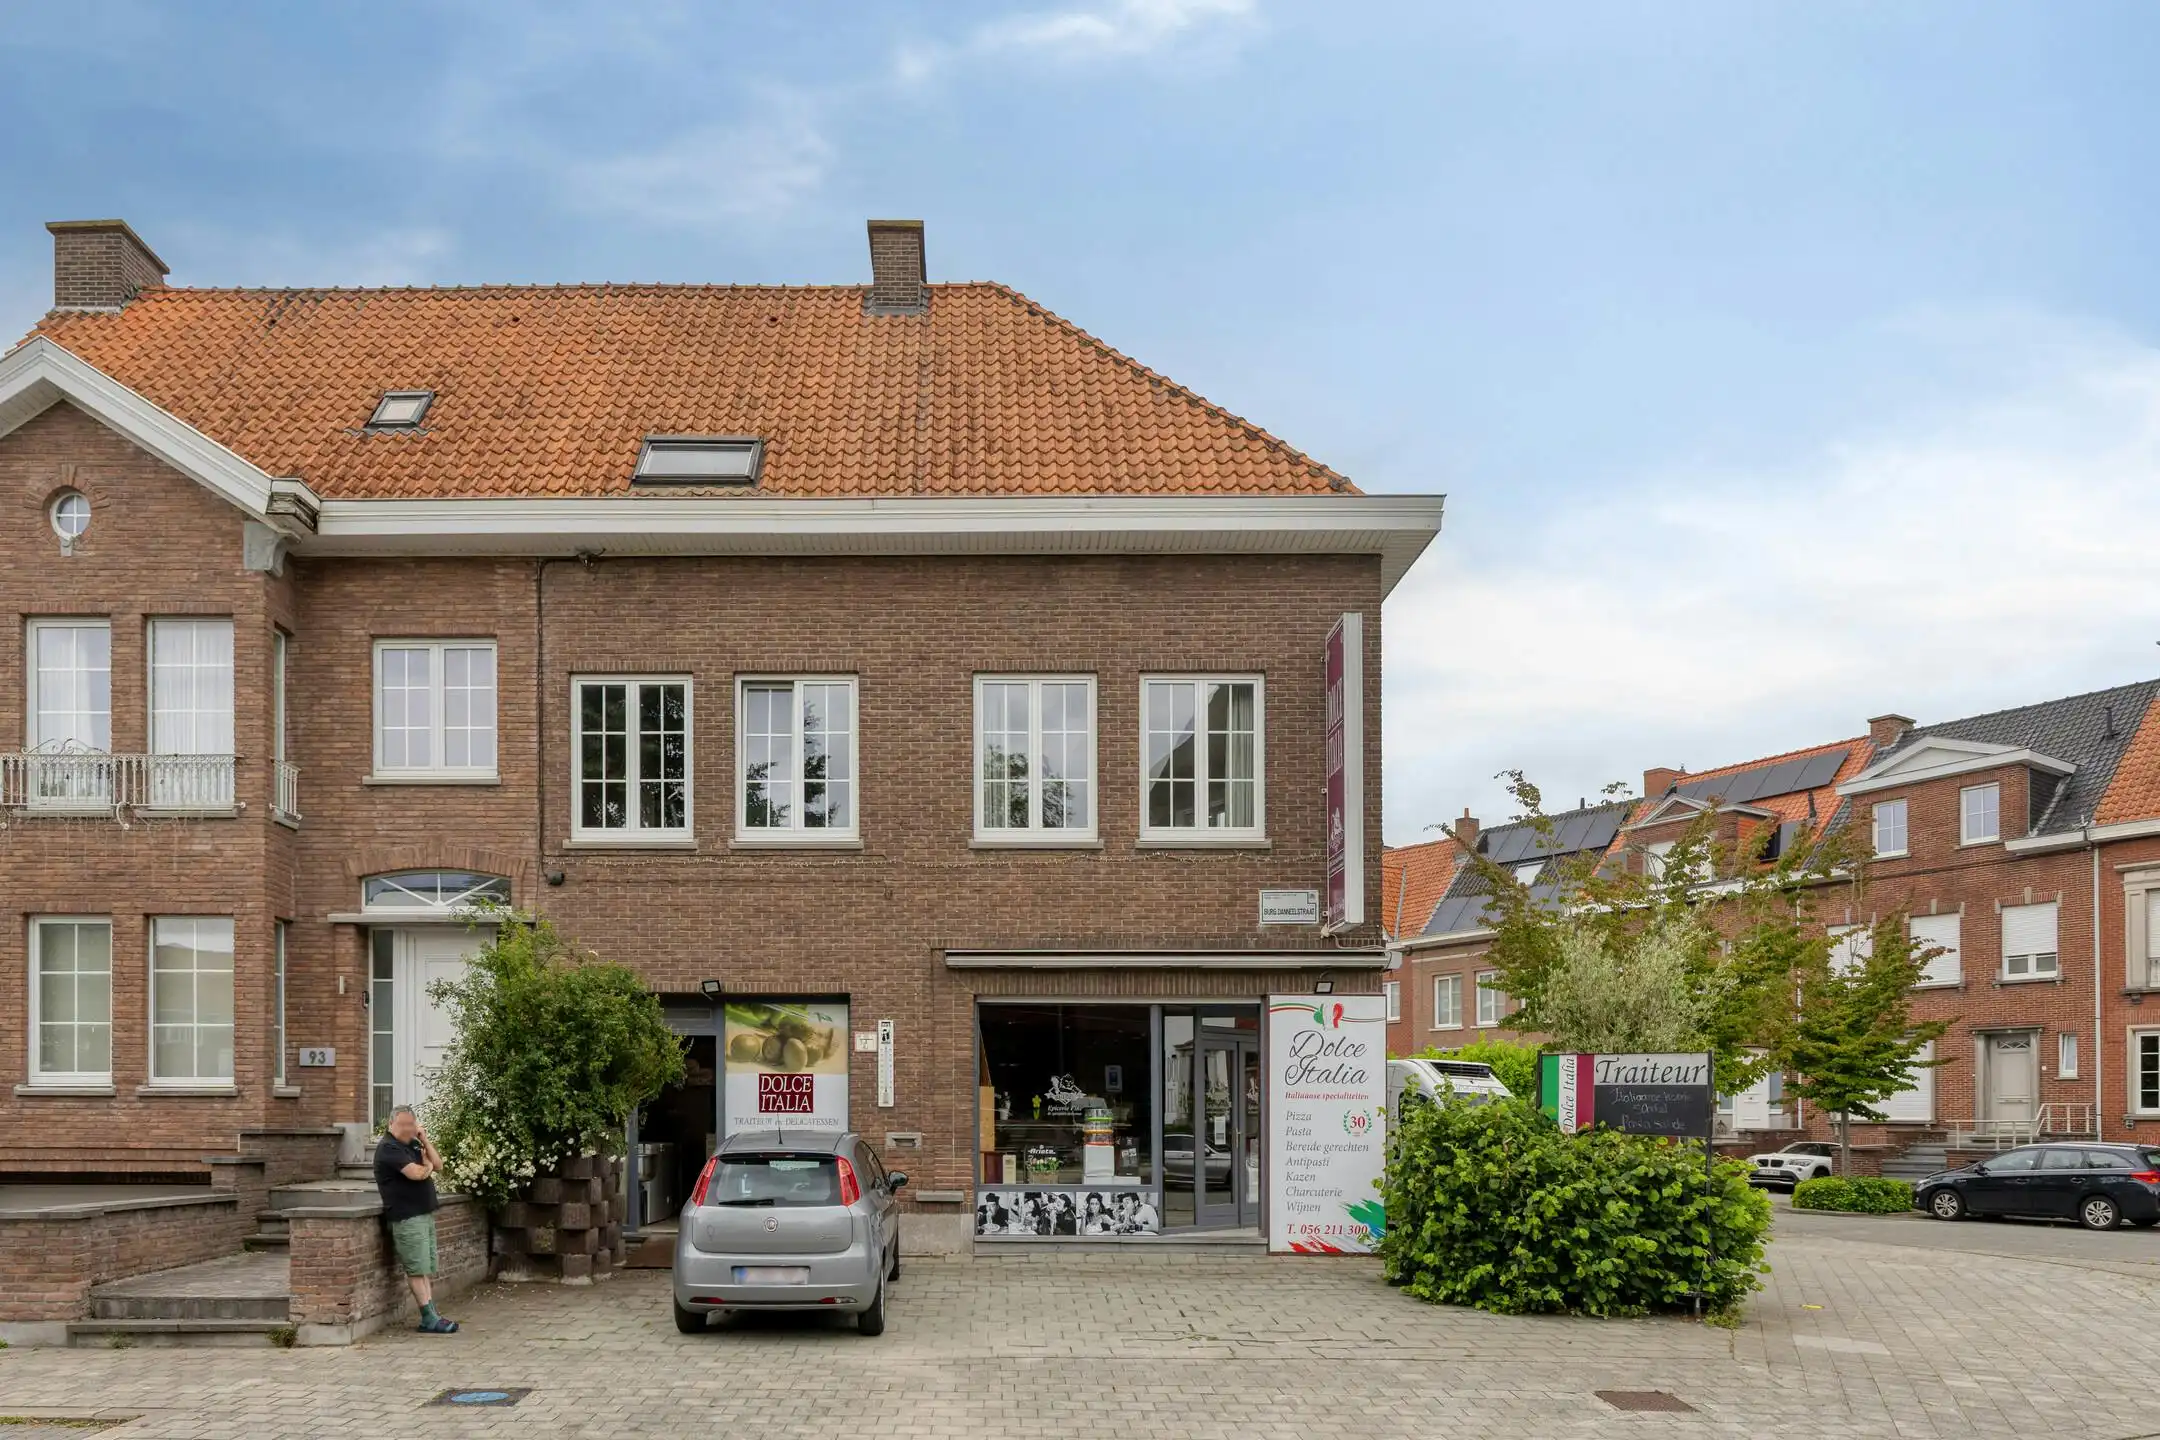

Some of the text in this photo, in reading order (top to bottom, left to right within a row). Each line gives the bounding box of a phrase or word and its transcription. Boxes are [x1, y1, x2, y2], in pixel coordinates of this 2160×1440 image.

[1289, 1030, 1367, 1059] Dolce
[308, 1050, 326, 1064] 93
[1284, 1054, 1369, 1086] Italia
[1595, 1057, 1706, 1084] Traiteur
[760, 1075, 812, 1093] DOLCE
[1285, 1092, 1369, 1101] Italiaanse specialiteiten
[1561, 1058, 1575, 1129] Dolce Italia
[760, 1094, 811, 1111] ITALIA
[734, 1117, 772, 1126] TRAITEUR
[785, 1117, 839, 1126] DELICATESSEN
[1285, 1110, 1312, 1121] Pizza
[1349, 1116, 1366, 1129] 30
[1285, 1126, 1312, 1136] Pasta
[1285, 1141, 1369, 1154] Bereide gerechten
[1285, 1157, 1330, 1169] Antipasti
[1285, 1171, 1316, 1182] Kazen
[1285, 1186, 1343, 1197] Charcuterie
[1287, 1201, 1320, 1214] Wijnen
[1287, 1223, 1368, 1235] T. 056 211 300
